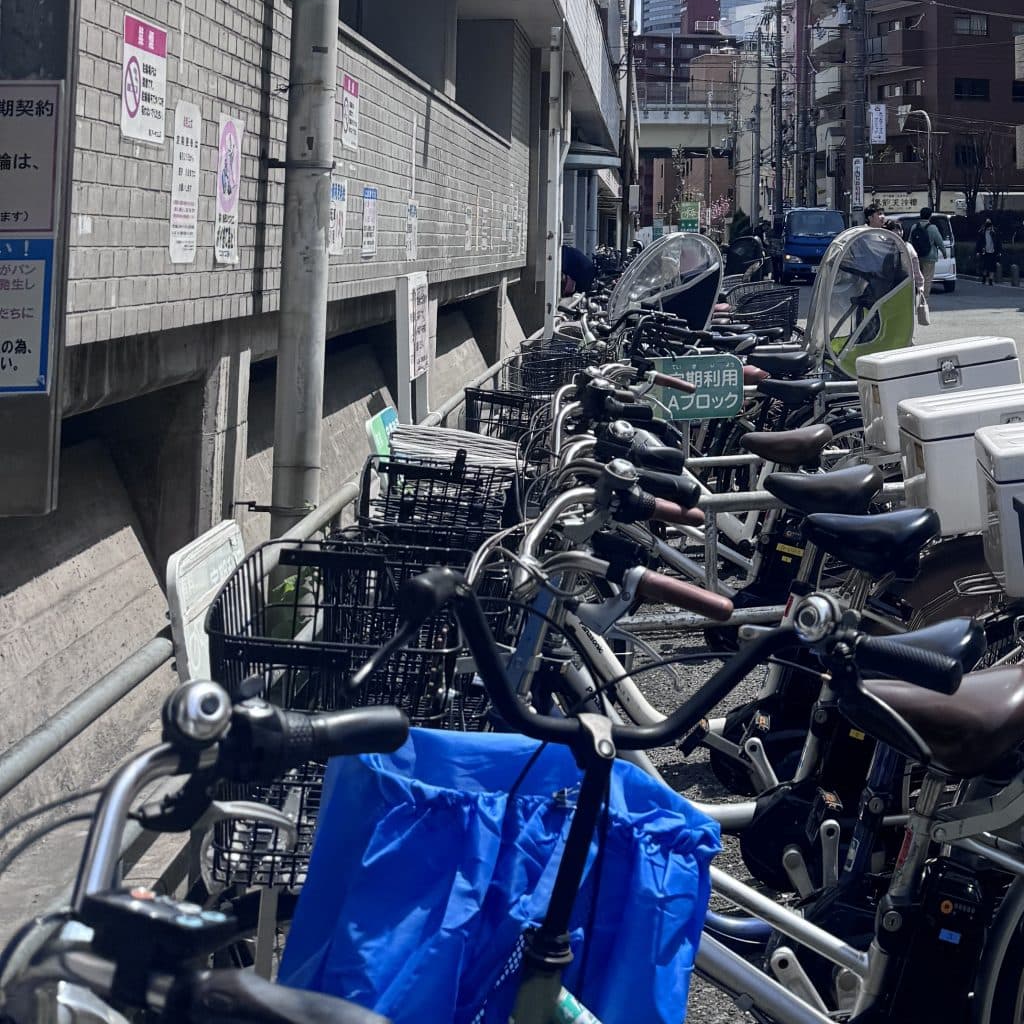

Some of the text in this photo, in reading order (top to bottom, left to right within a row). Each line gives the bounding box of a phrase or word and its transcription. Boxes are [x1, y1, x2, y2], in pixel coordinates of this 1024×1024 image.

[0, 99, 54, 117] 期契約
[668, 392, 738, 410] Aブロック
